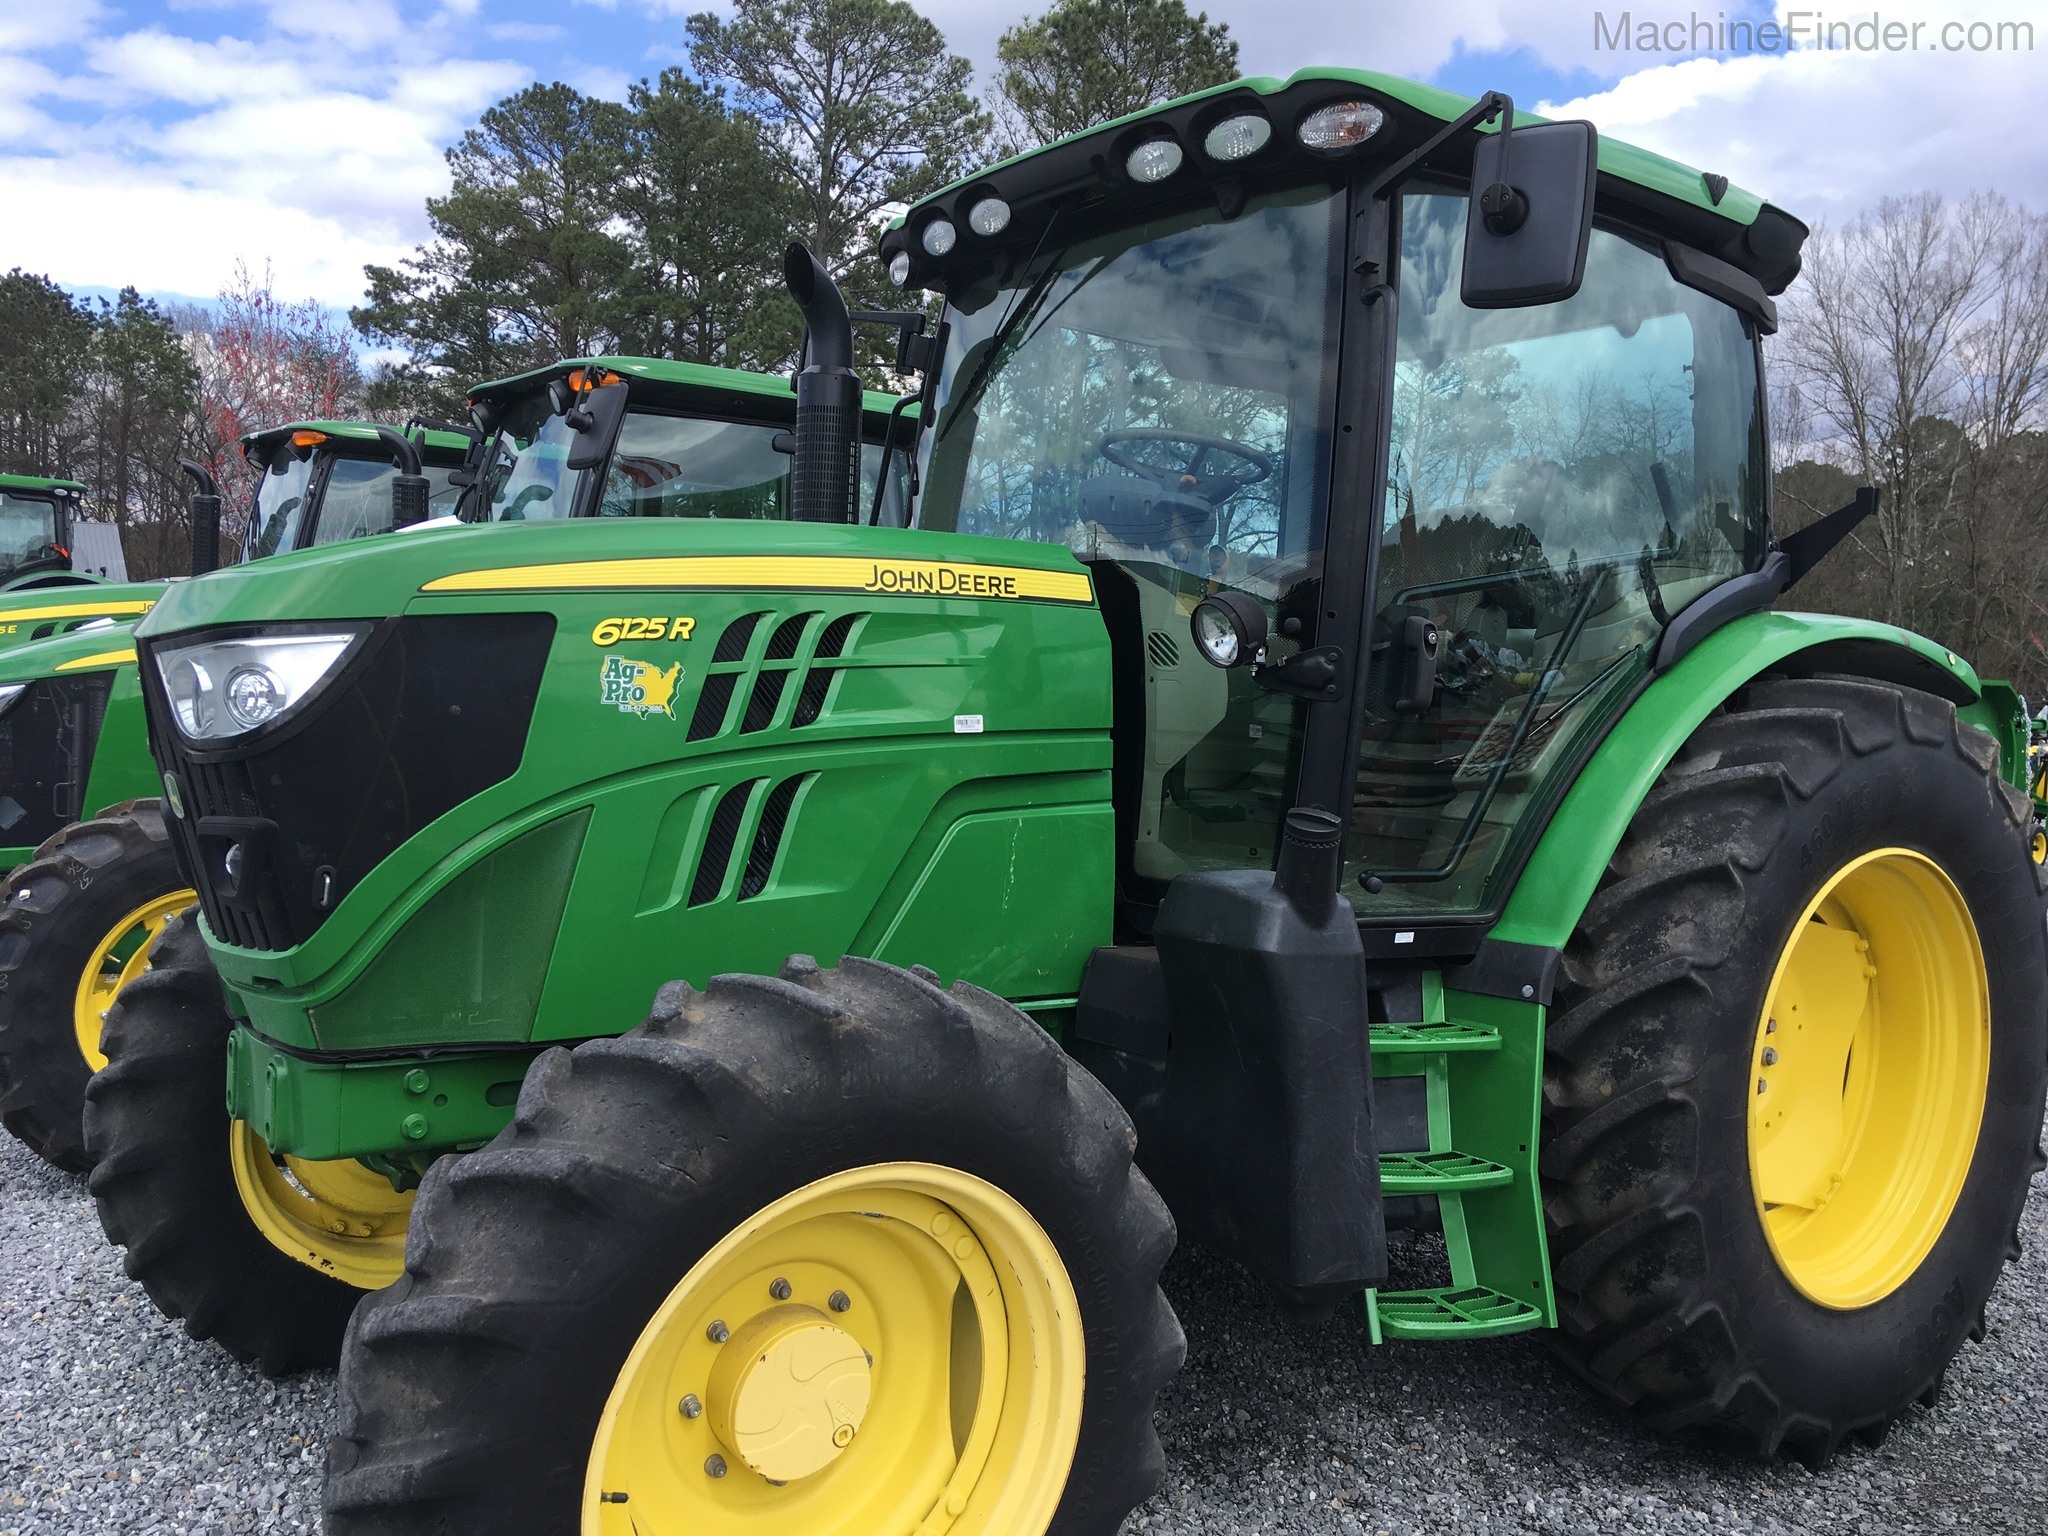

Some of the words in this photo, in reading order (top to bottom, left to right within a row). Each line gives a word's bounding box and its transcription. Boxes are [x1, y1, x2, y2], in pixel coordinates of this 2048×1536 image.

[865, 565, 934, 589] JOHN
[938, 568, 1016, 594] DEERE
[604, 658, 645, 683] Ag-
[604, 680, 645, 702] Pro
